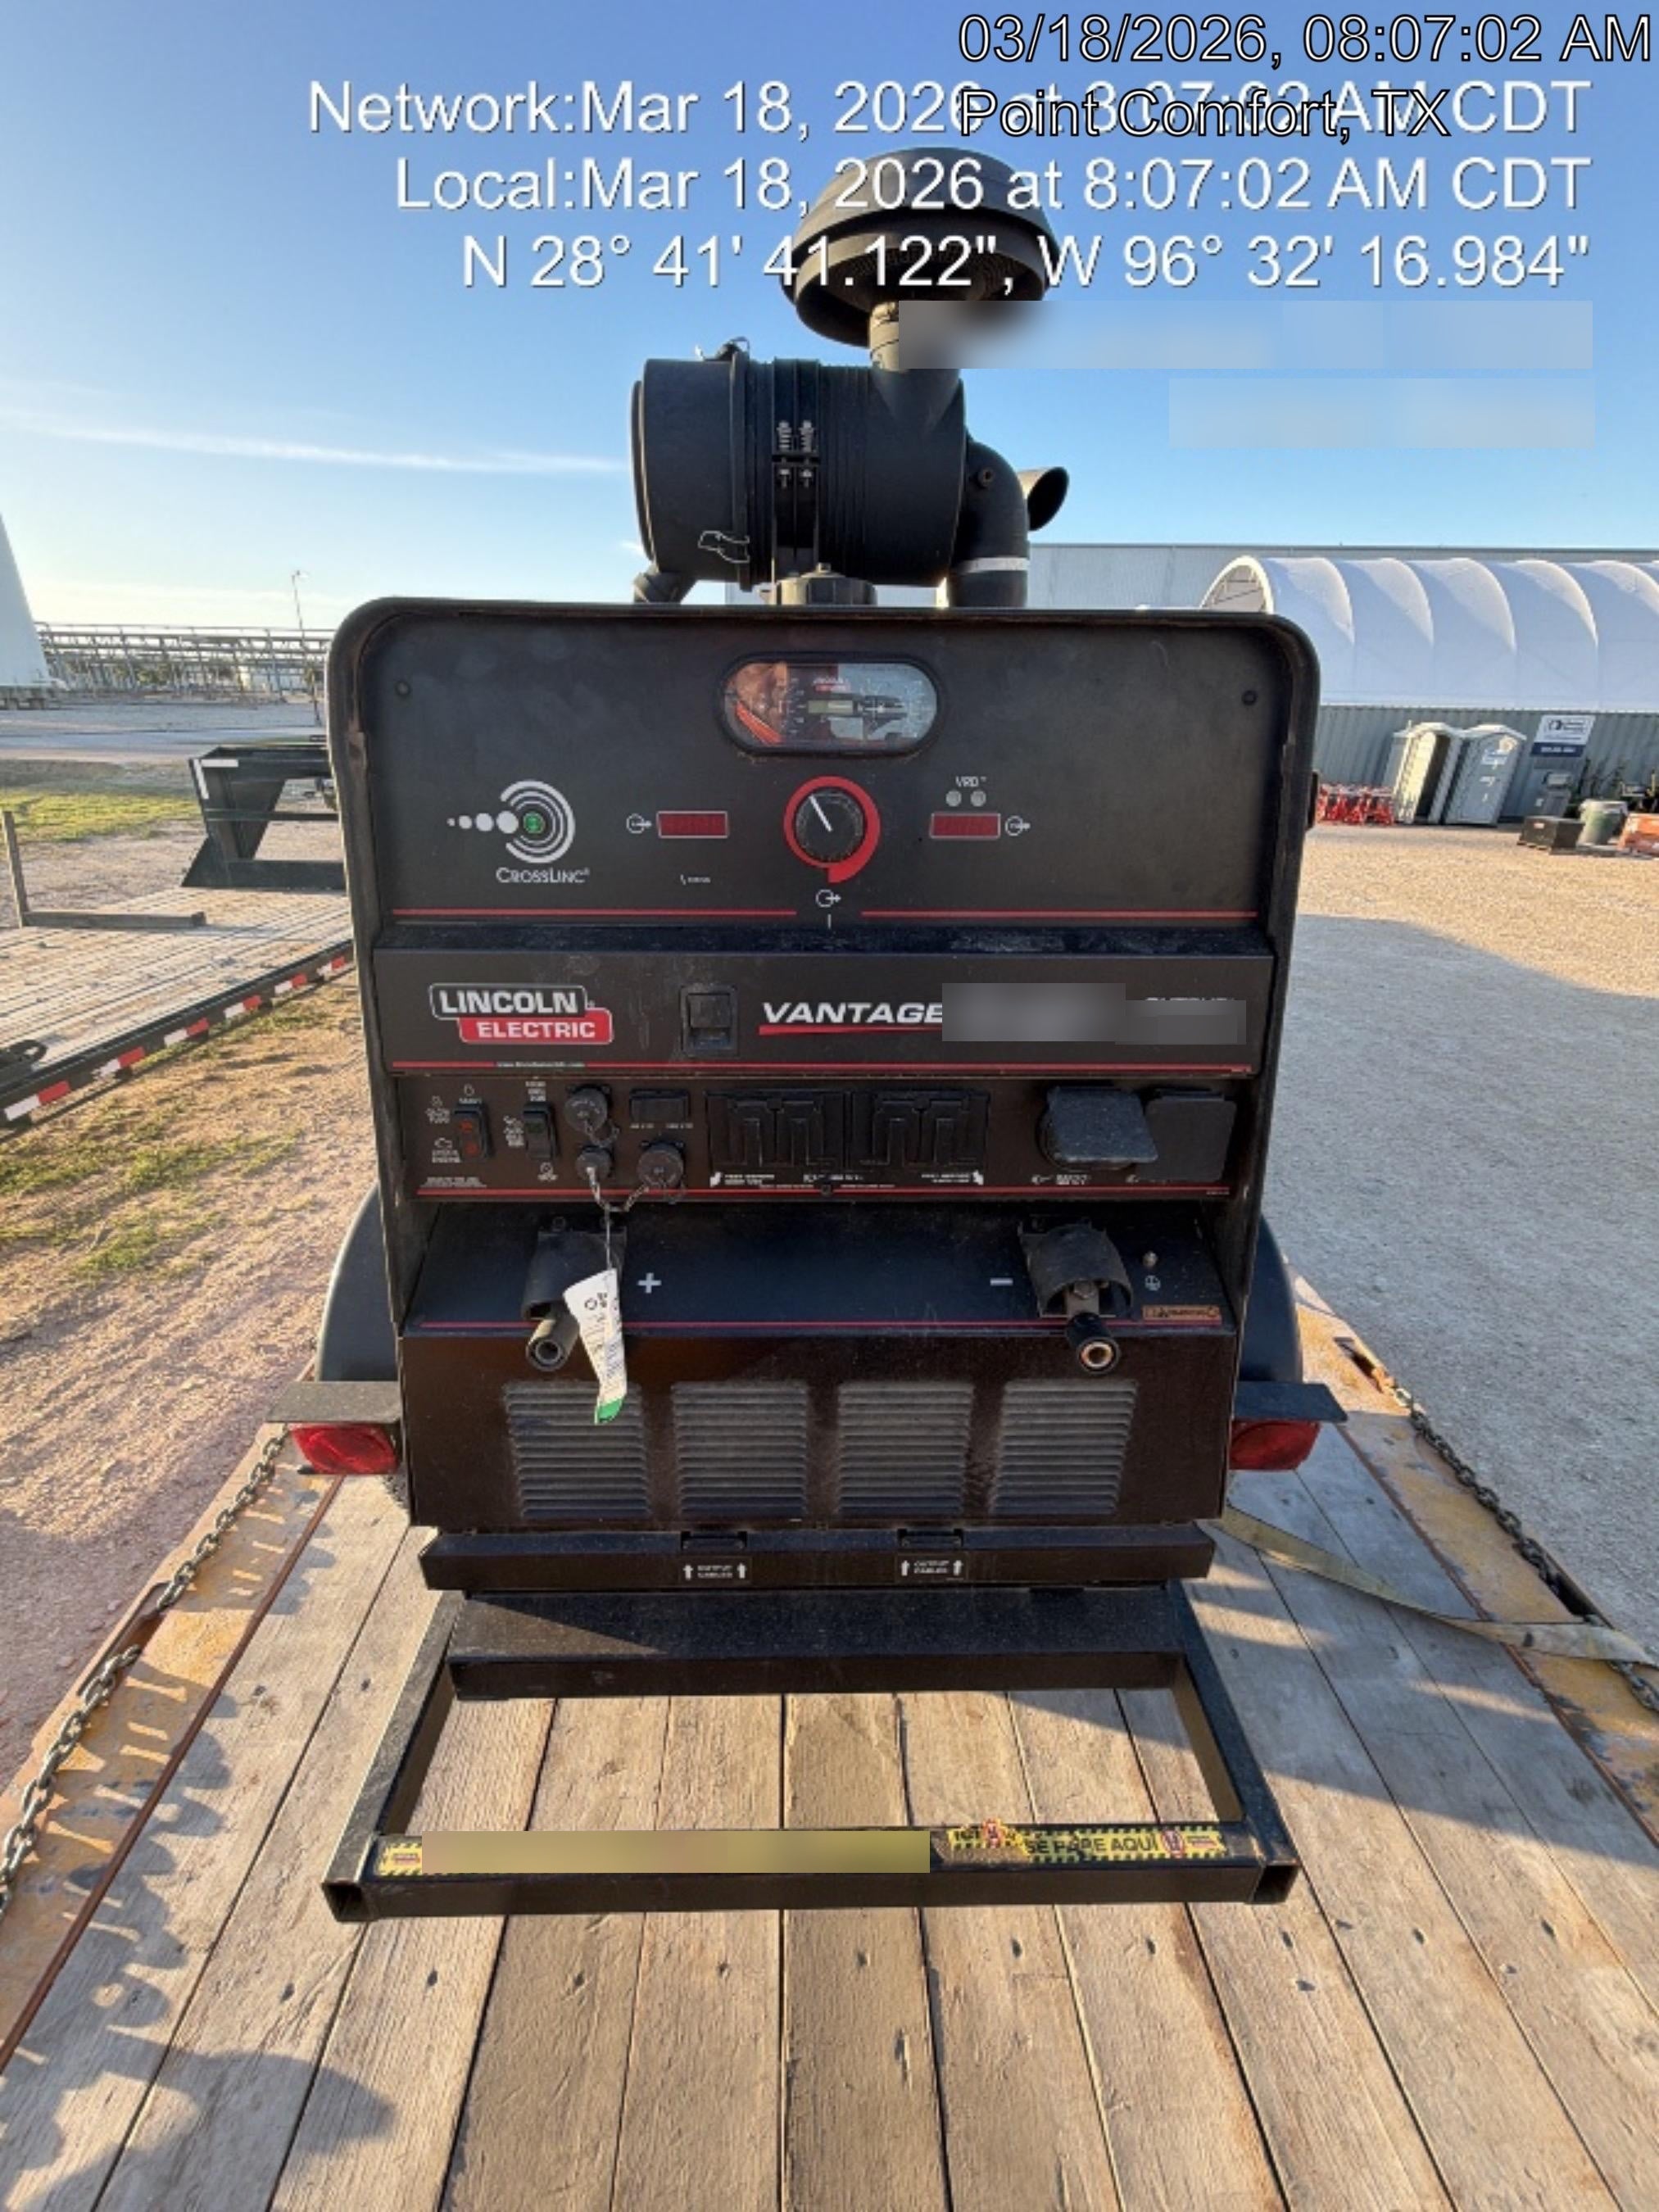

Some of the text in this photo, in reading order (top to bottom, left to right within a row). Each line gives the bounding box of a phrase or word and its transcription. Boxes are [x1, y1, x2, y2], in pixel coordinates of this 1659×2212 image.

[438, 990, 578, 1014] LINCOLN
[762, 1002, 943, 1023] VANTAGE
[476, 1021, 596, 1038] ELECTRIC
